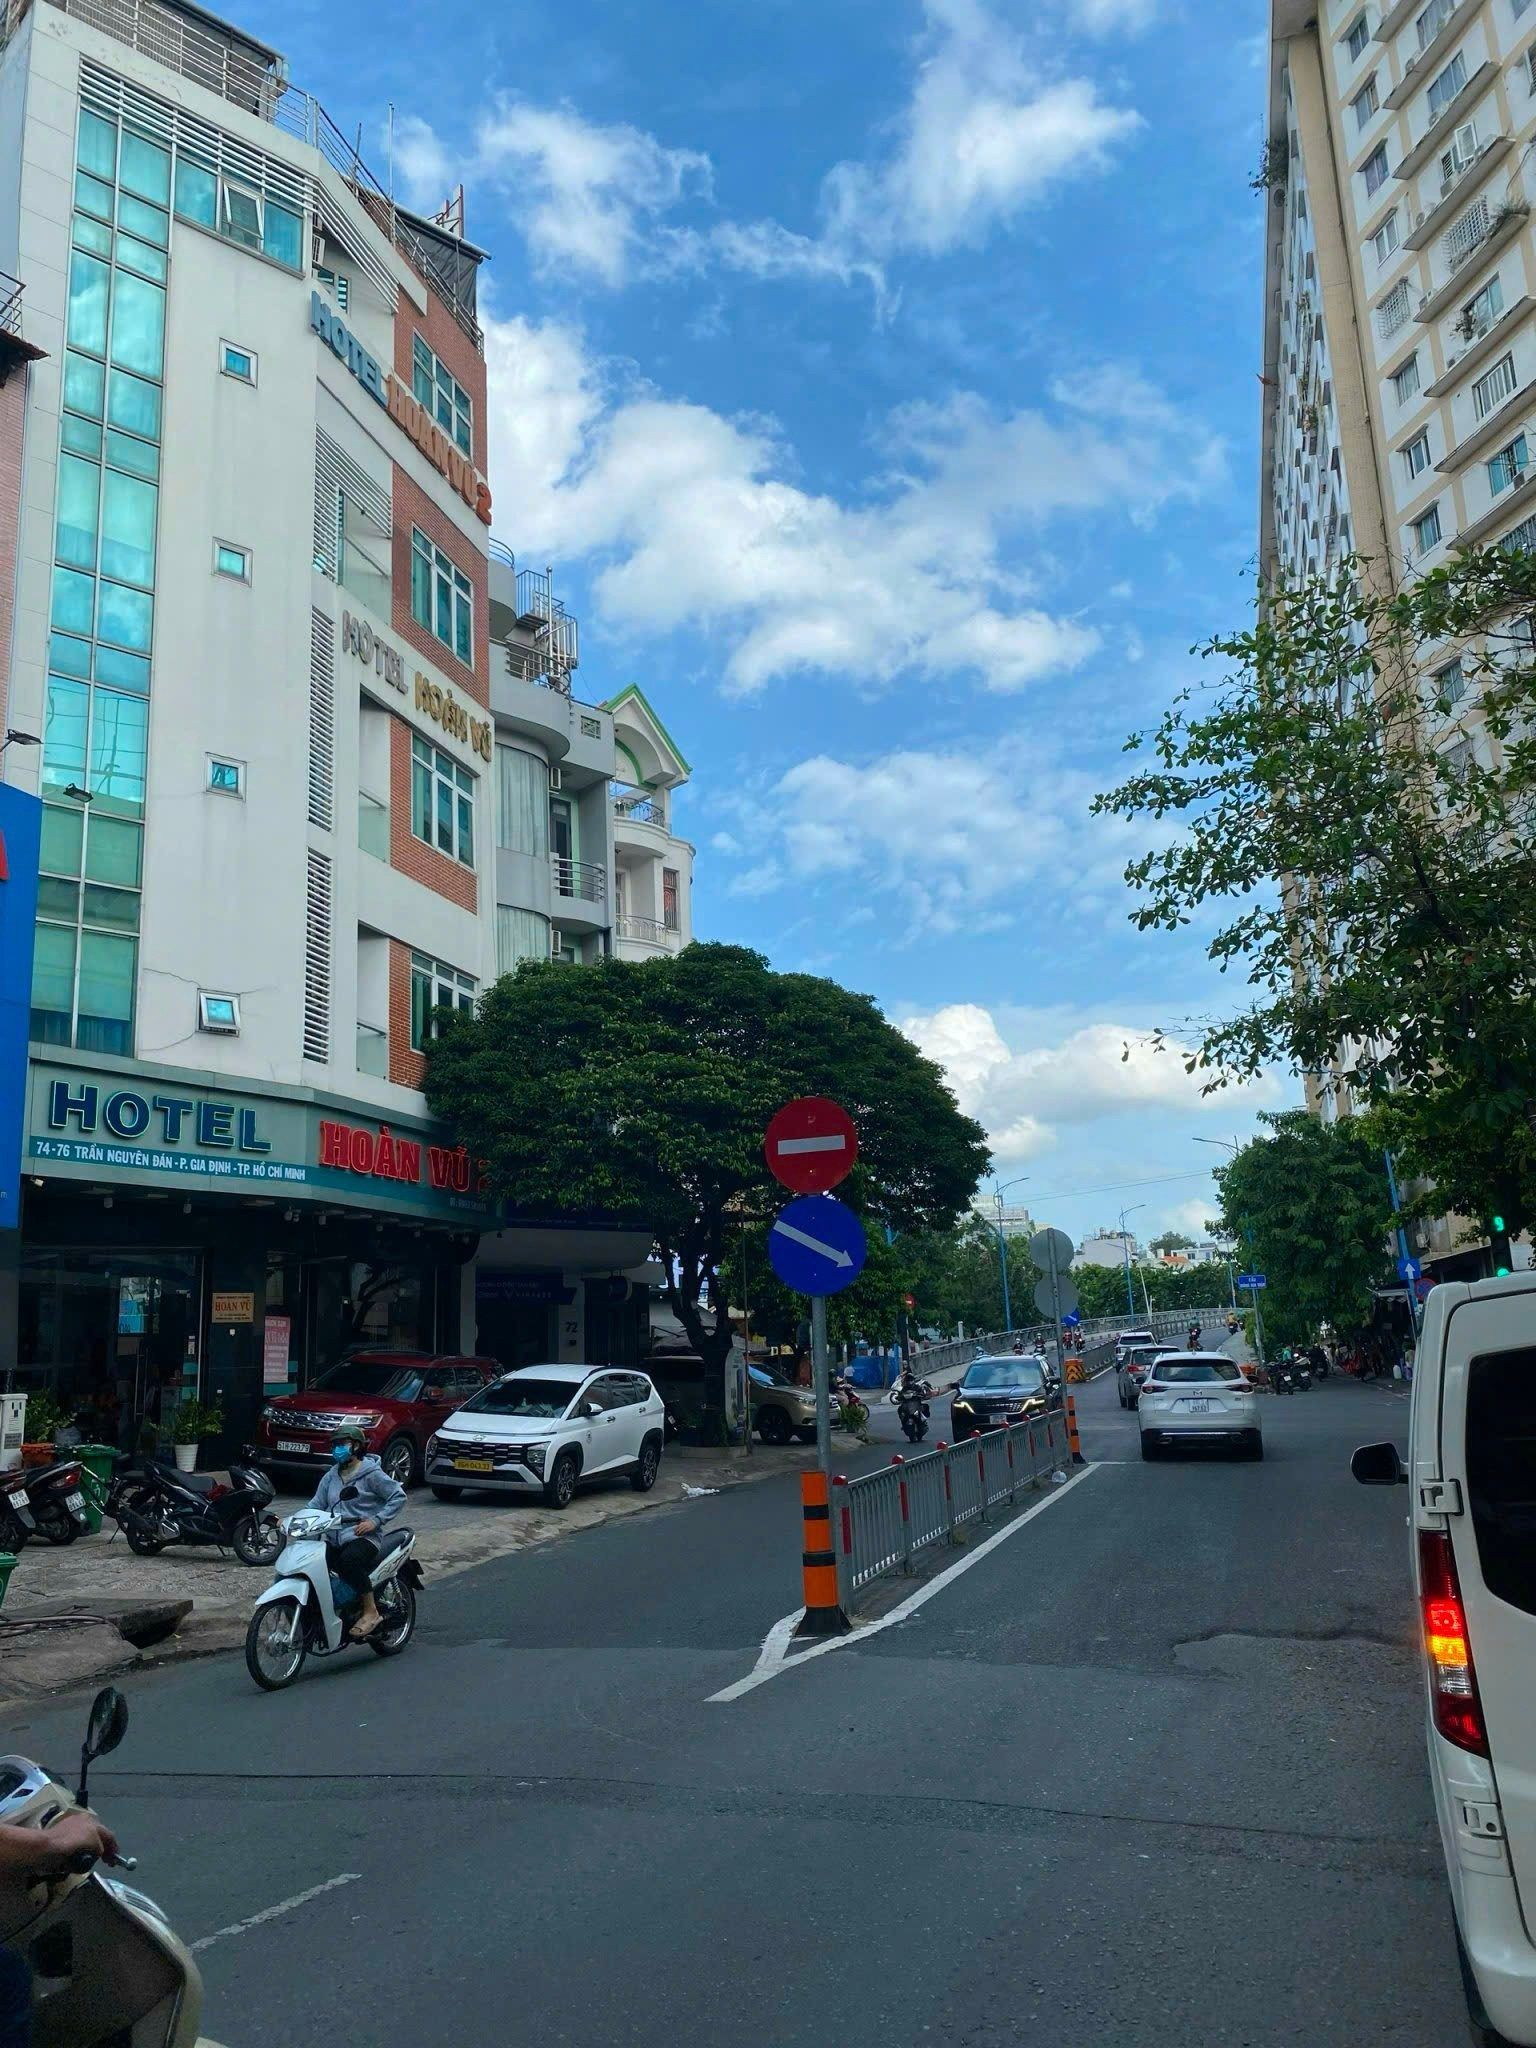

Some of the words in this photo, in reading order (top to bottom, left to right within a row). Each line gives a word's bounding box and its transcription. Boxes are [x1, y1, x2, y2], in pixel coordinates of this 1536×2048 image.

[311, 290, 388, 410] HOTEL
[476, 481, 493, 526] 2
[342, 609, 408, 695] HOTEL
[414, 671, 468, 743] HOÀN
[49, 1080, 272, 1152] HOTEL
[74, 1143, 104, 1161] TRẦN
[107, 1149, 149, 1166] NGUYÊN
[152, 1153, 173, 1169] ĐÁN
[190, 1158, 206, 1171] GIA
[208, 1160, 231, 1175] ĐỊNH
[267, 1164, 283, 1178] CHÍ
[284, 1167, 306, 1180] MINH
[319, 1120, 422, 1183] HOÀN
[428, 1145, 471, 1192] VŨ
[566, 1321, 578, 1333] 72
